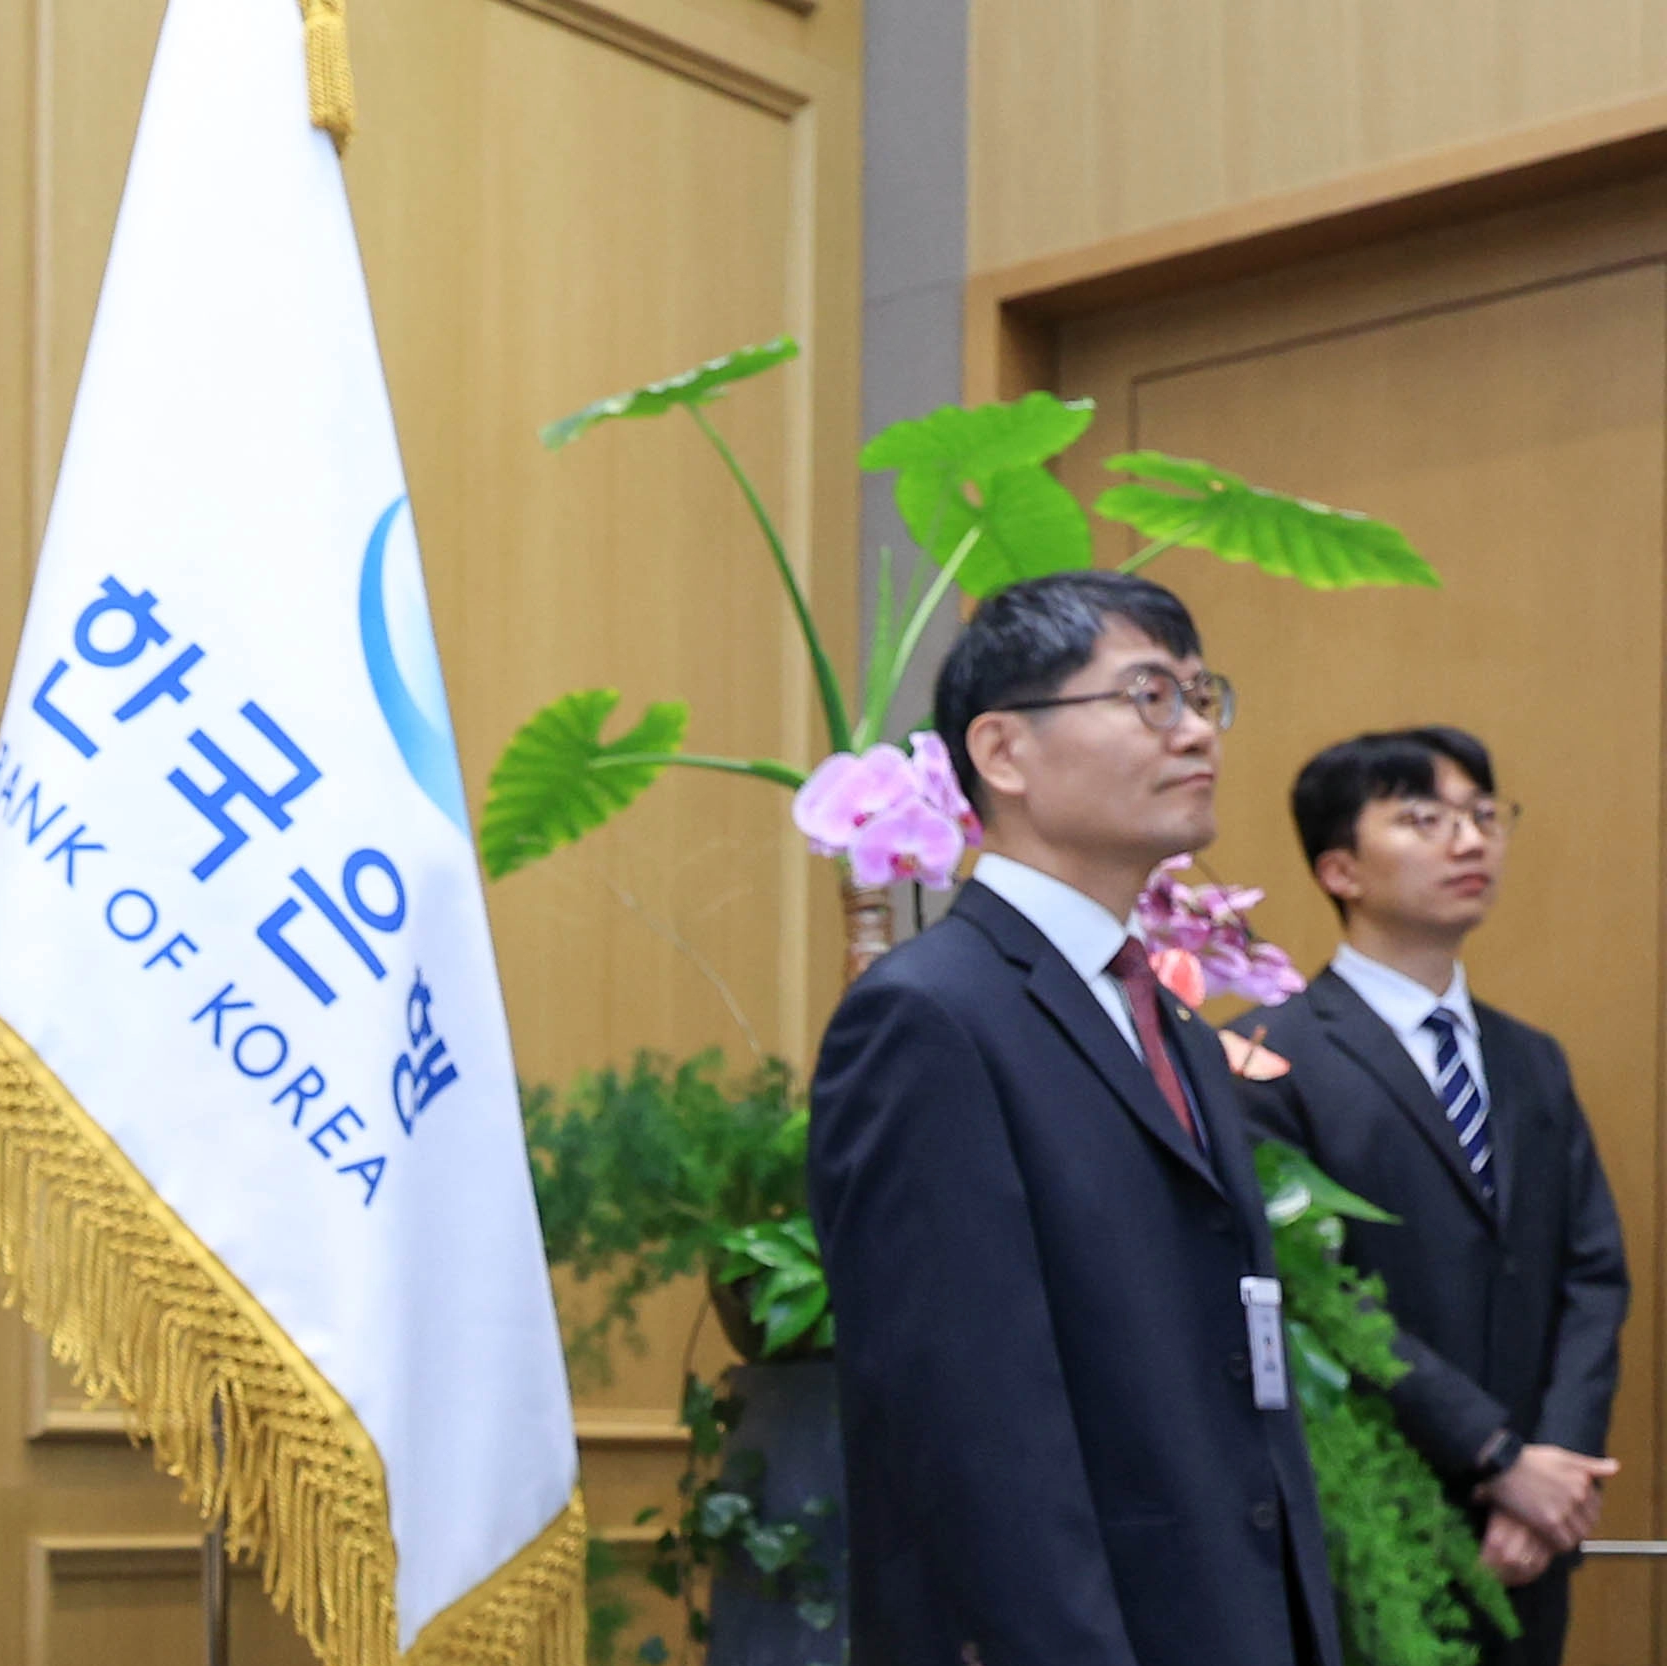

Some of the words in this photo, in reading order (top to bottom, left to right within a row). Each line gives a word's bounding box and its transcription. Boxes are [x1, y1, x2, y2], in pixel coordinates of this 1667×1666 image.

[31, 575, 459, 1136] 한국은행
[105, 889, 199, 970] OF
[190, 983, 387, 1206] KOREA
